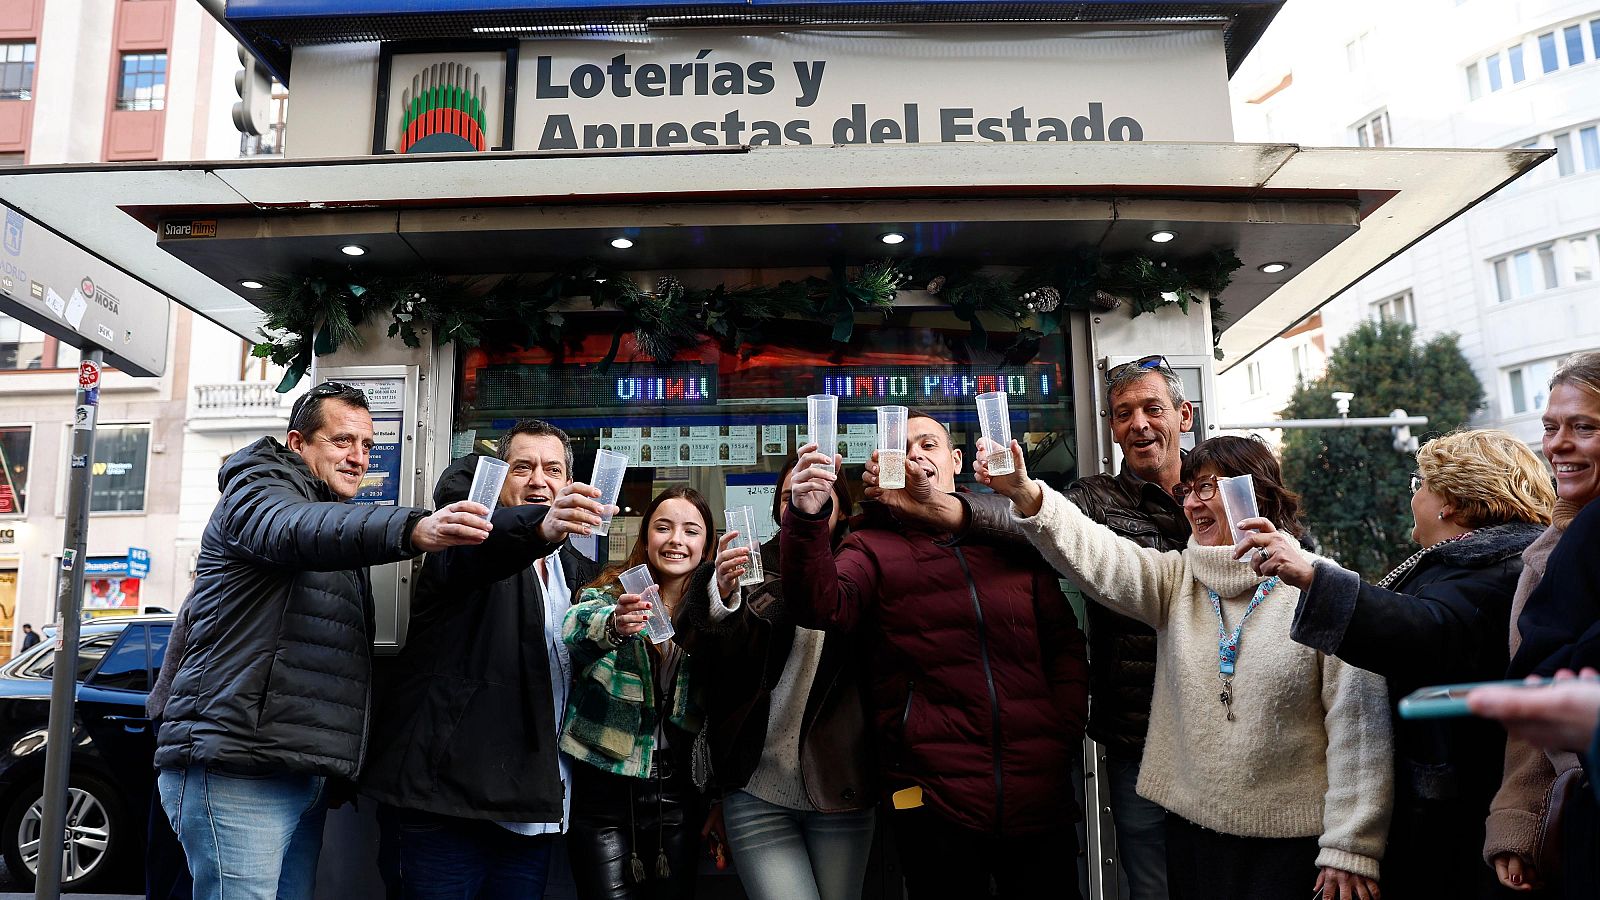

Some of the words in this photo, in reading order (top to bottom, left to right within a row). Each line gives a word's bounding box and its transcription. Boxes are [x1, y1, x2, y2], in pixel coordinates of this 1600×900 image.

[535, 49, 776, 100] Loterías
[793, 60, 826, 108] y
[537, 109, 814, 151] Apuestas
[832, 102, 920, 145] del
[939, 101, 1144, 143] Estado
[94, 292, 120, 316] MOSA
